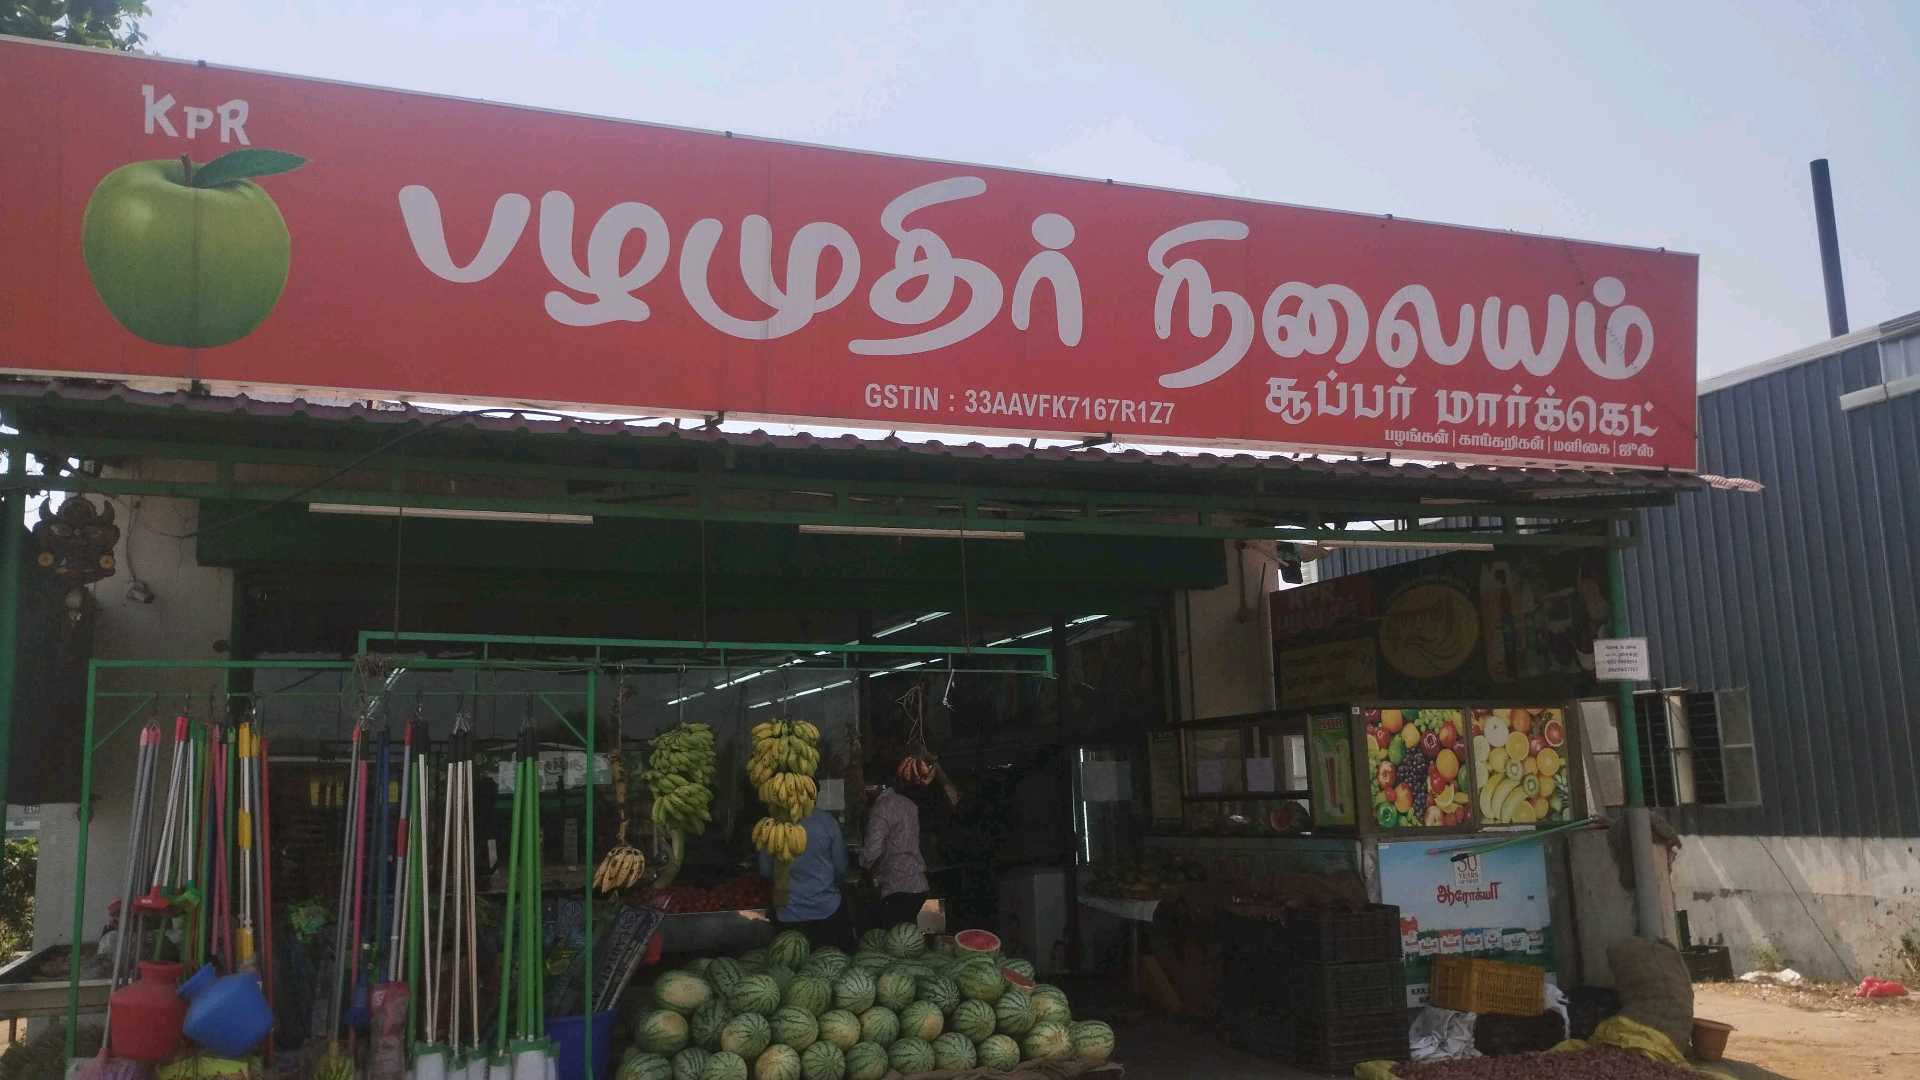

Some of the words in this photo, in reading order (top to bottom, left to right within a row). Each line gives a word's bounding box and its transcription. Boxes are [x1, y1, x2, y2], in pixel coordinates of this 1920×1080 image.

[142, 84, 250, 145] KPR
[399, 175, 1083, 355] பழமுதிர்
[1147, 217, 1655, 388] நிலையம்
[865, 383, 939, 411] GSTIN
[964, 389, 1176, 425] 33AAVFK7167R1Z7
[1265, 369, 1417, 425] சூப்பர்
[1434, 383, 1658, 437] மார்க்கெட்
[1384, 428, 1449, 447] பழங்கள்
[1458, 431, 1545, 451] காய்கறிகள்
[1553, 438, 1611, 455] மளிகை
